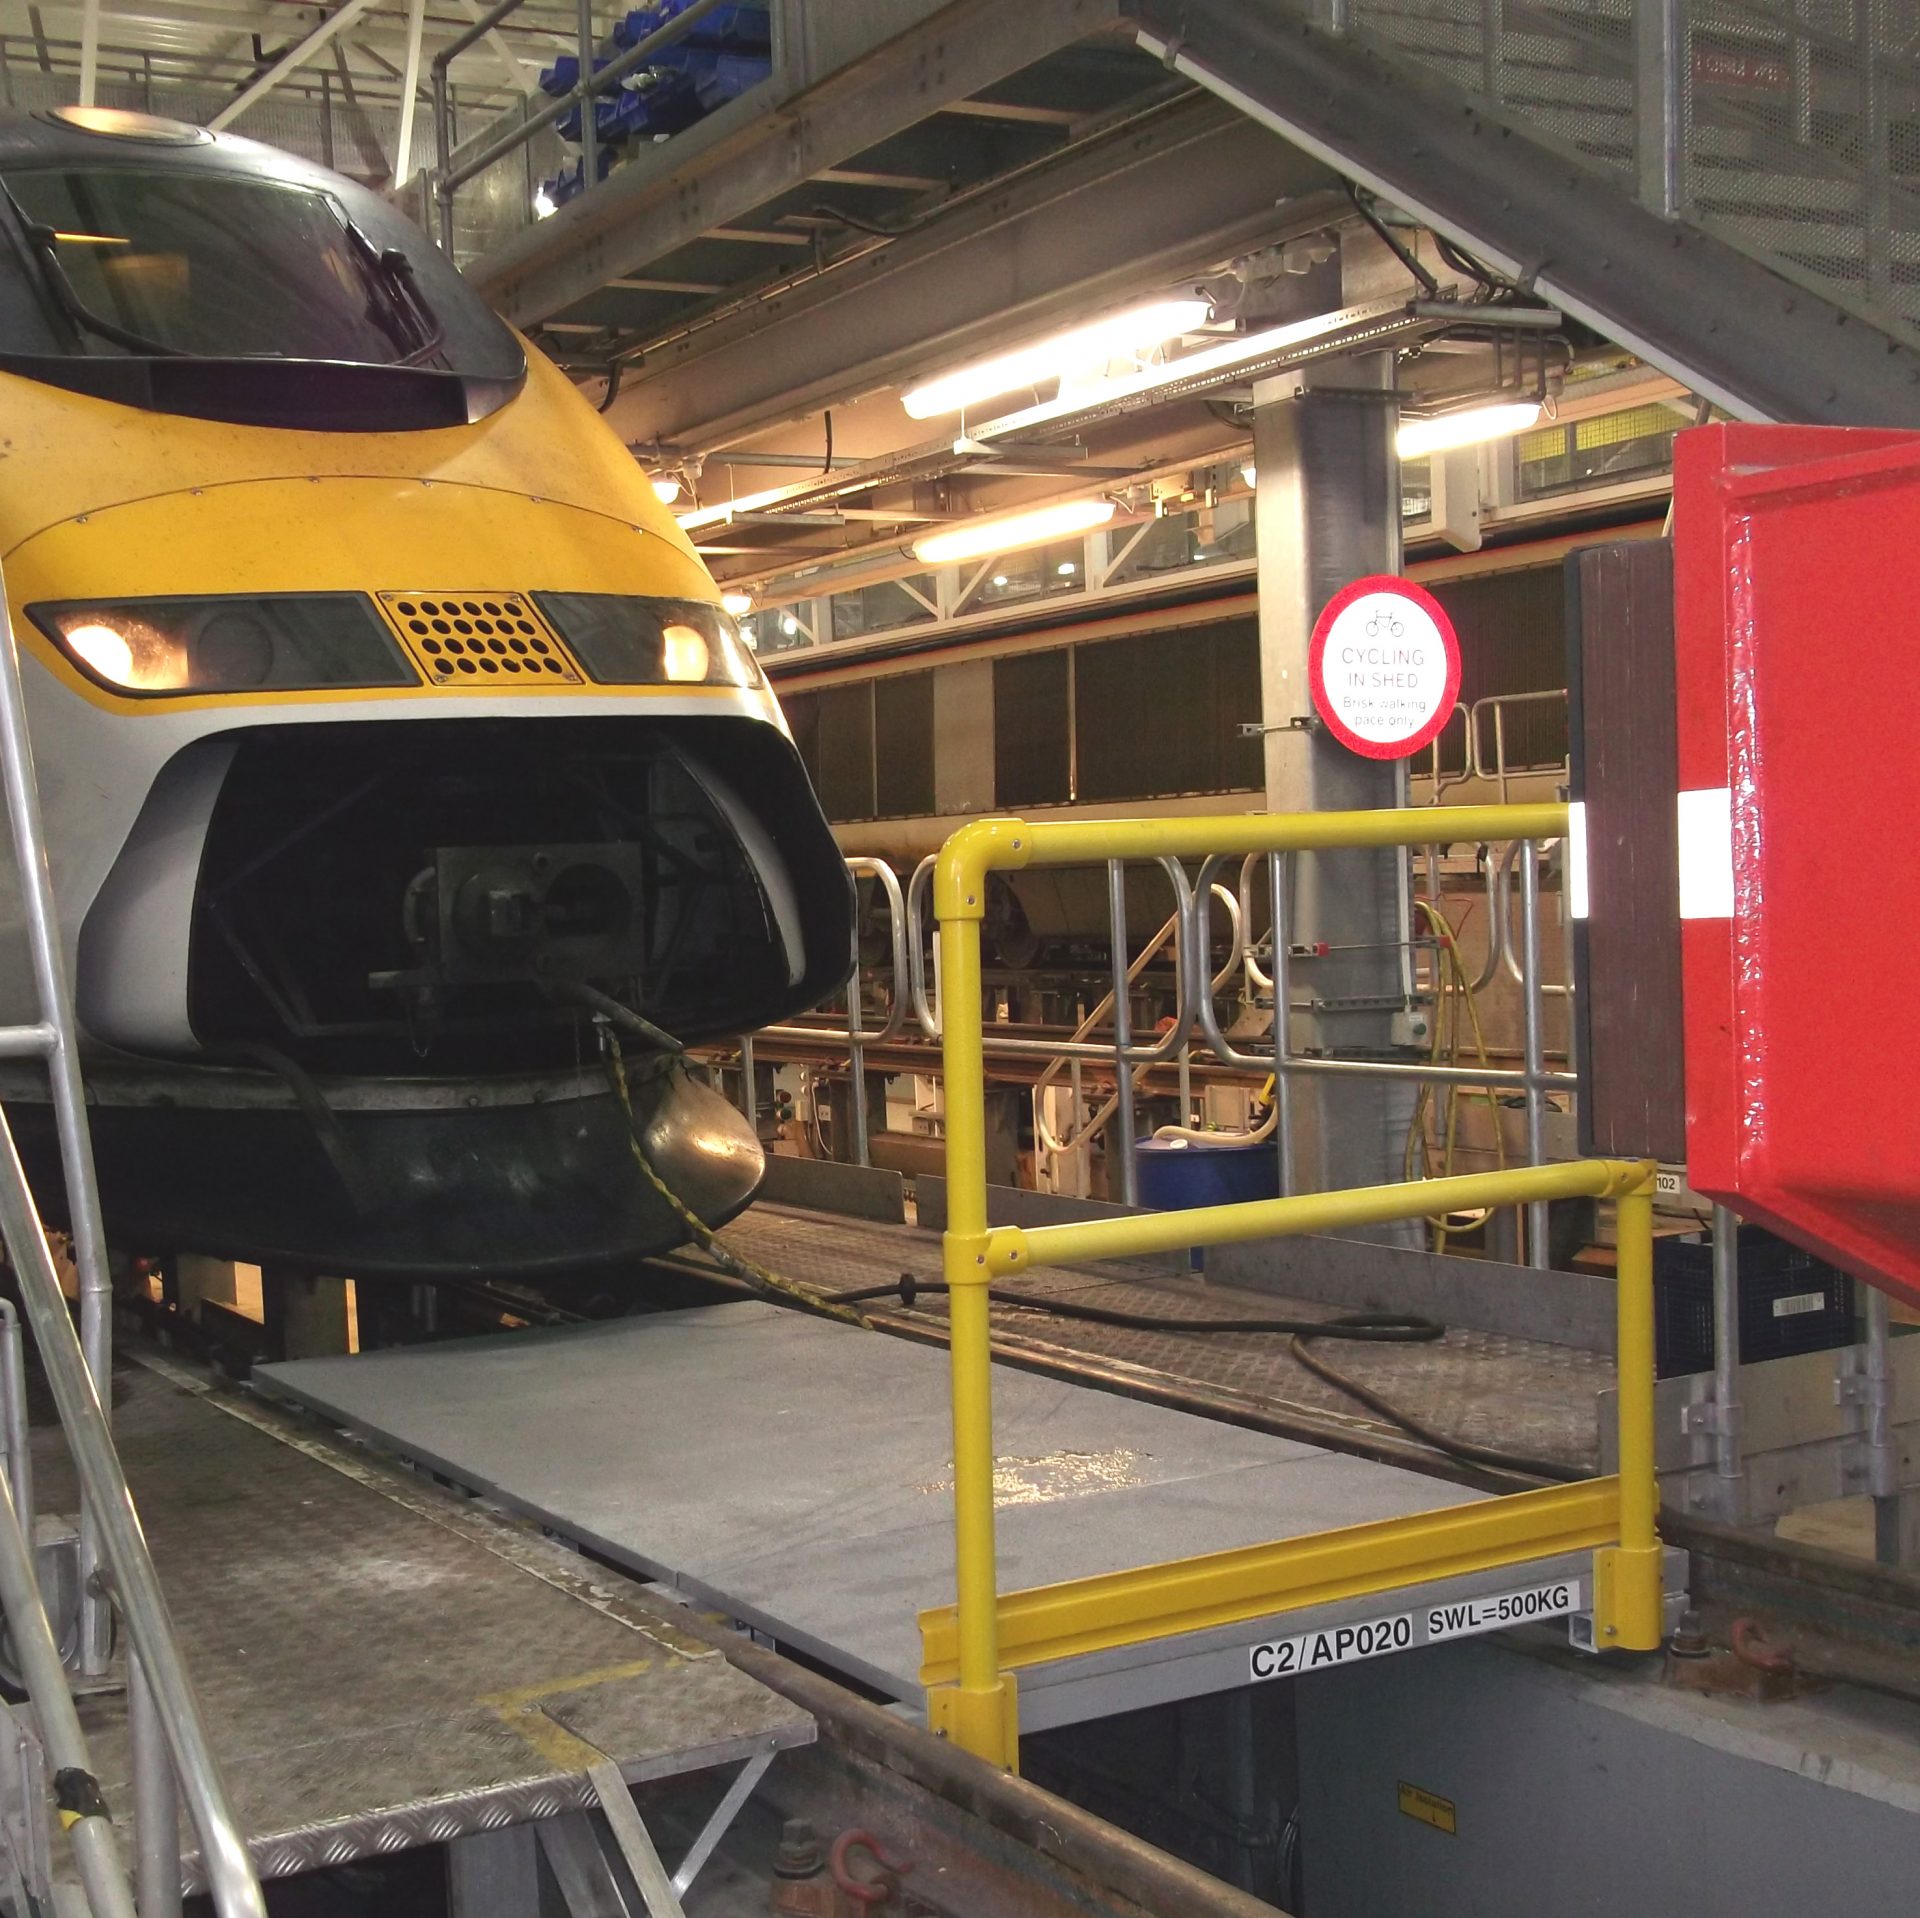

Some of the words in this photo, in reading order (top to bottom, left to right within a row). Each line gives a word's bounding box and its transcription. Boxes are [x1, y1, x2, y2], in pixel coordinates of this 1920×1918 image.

[1341, 647, 1424, 666] CYCLING
[1349, 672, 1365, 687] IN
[1372, 672, 1419, 688] SHED
[1343, 696, 1374, 709] Brisk
[1379, 697, 1426, 712] walking
[1355, 715, 1384, 727] pace
[1388, 715, 1414, 728] only
[1251, 1616, 1412, 1677] C2/AP020
[1428, 1585, 1569, 1635] SWL=500KG
